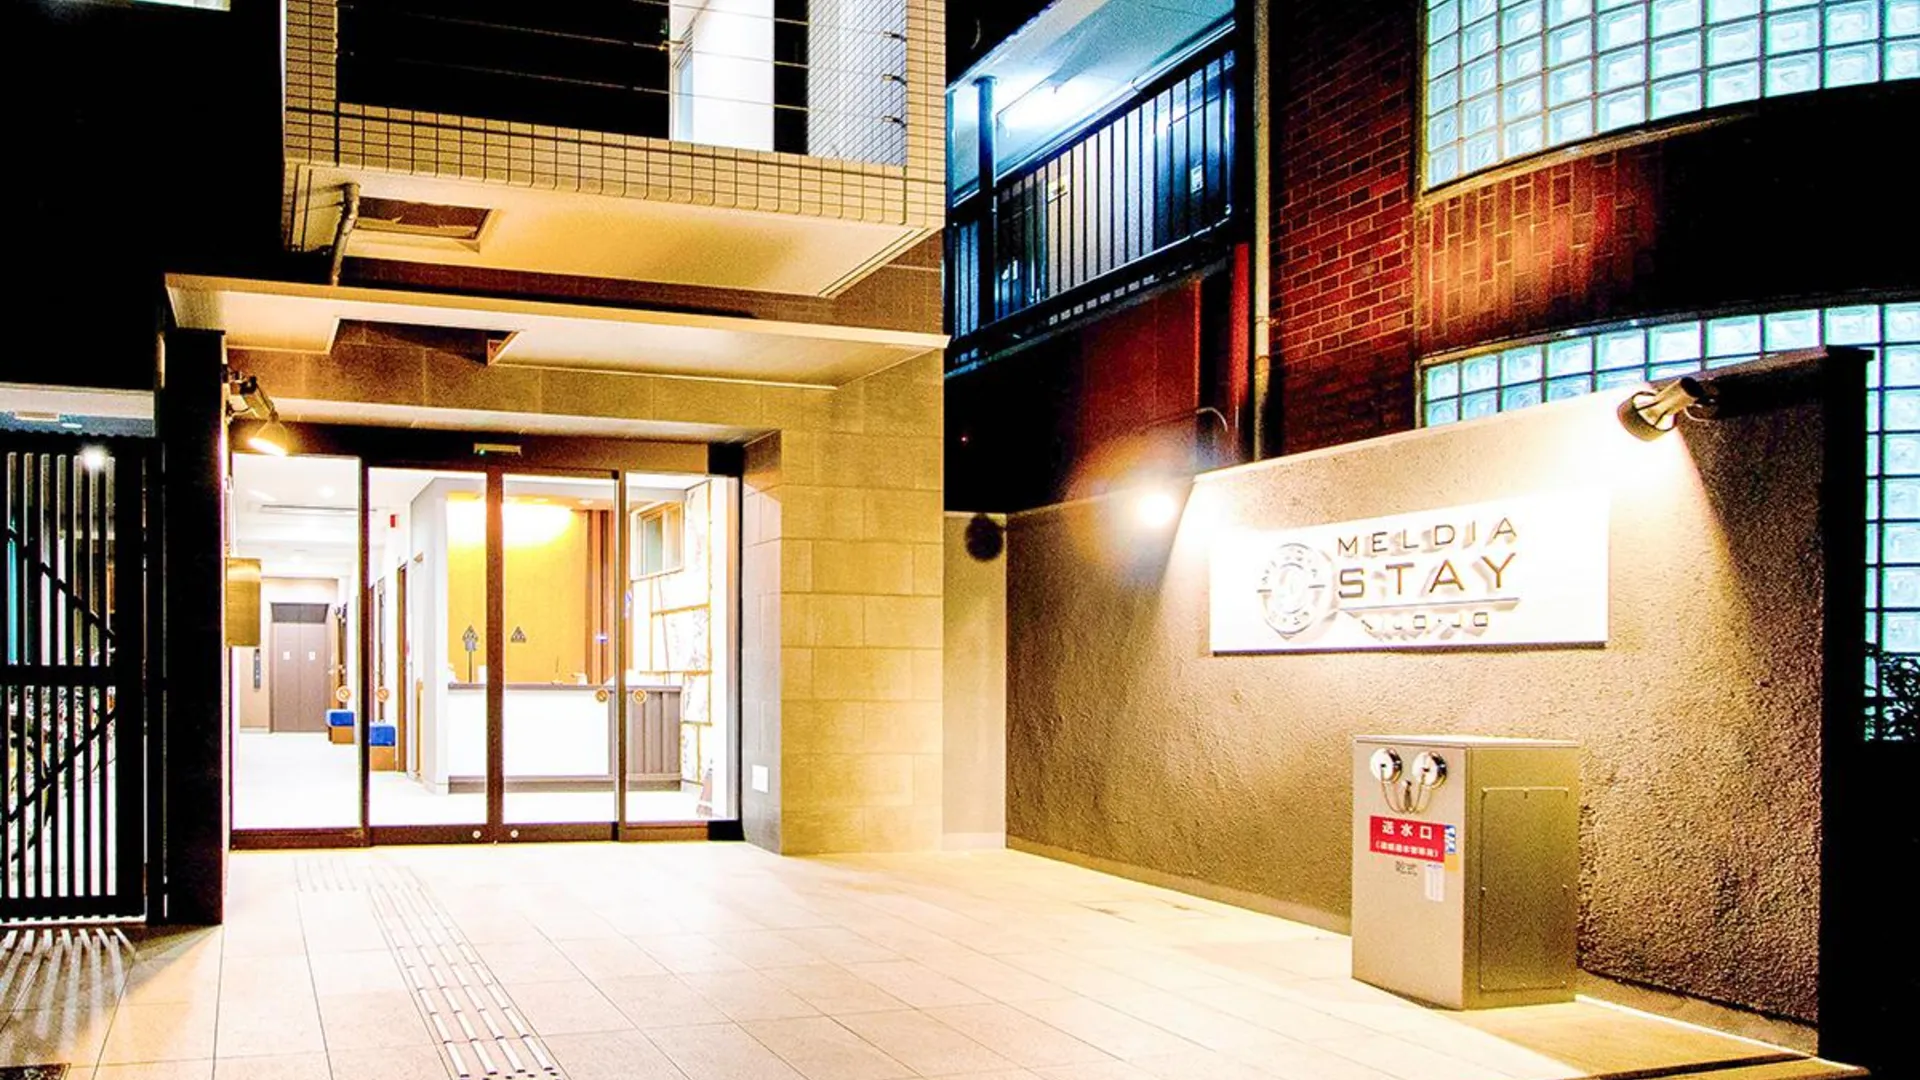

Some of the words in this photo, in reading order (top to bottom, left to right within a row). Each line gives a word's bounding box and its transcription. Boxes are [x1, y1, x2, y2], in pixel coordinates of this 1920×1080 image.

[1337, 517, 1517, 556] MELDIA
[1338, 552, 1516, 598] STAY
[1381, 820, 1432, 840] 送水口
